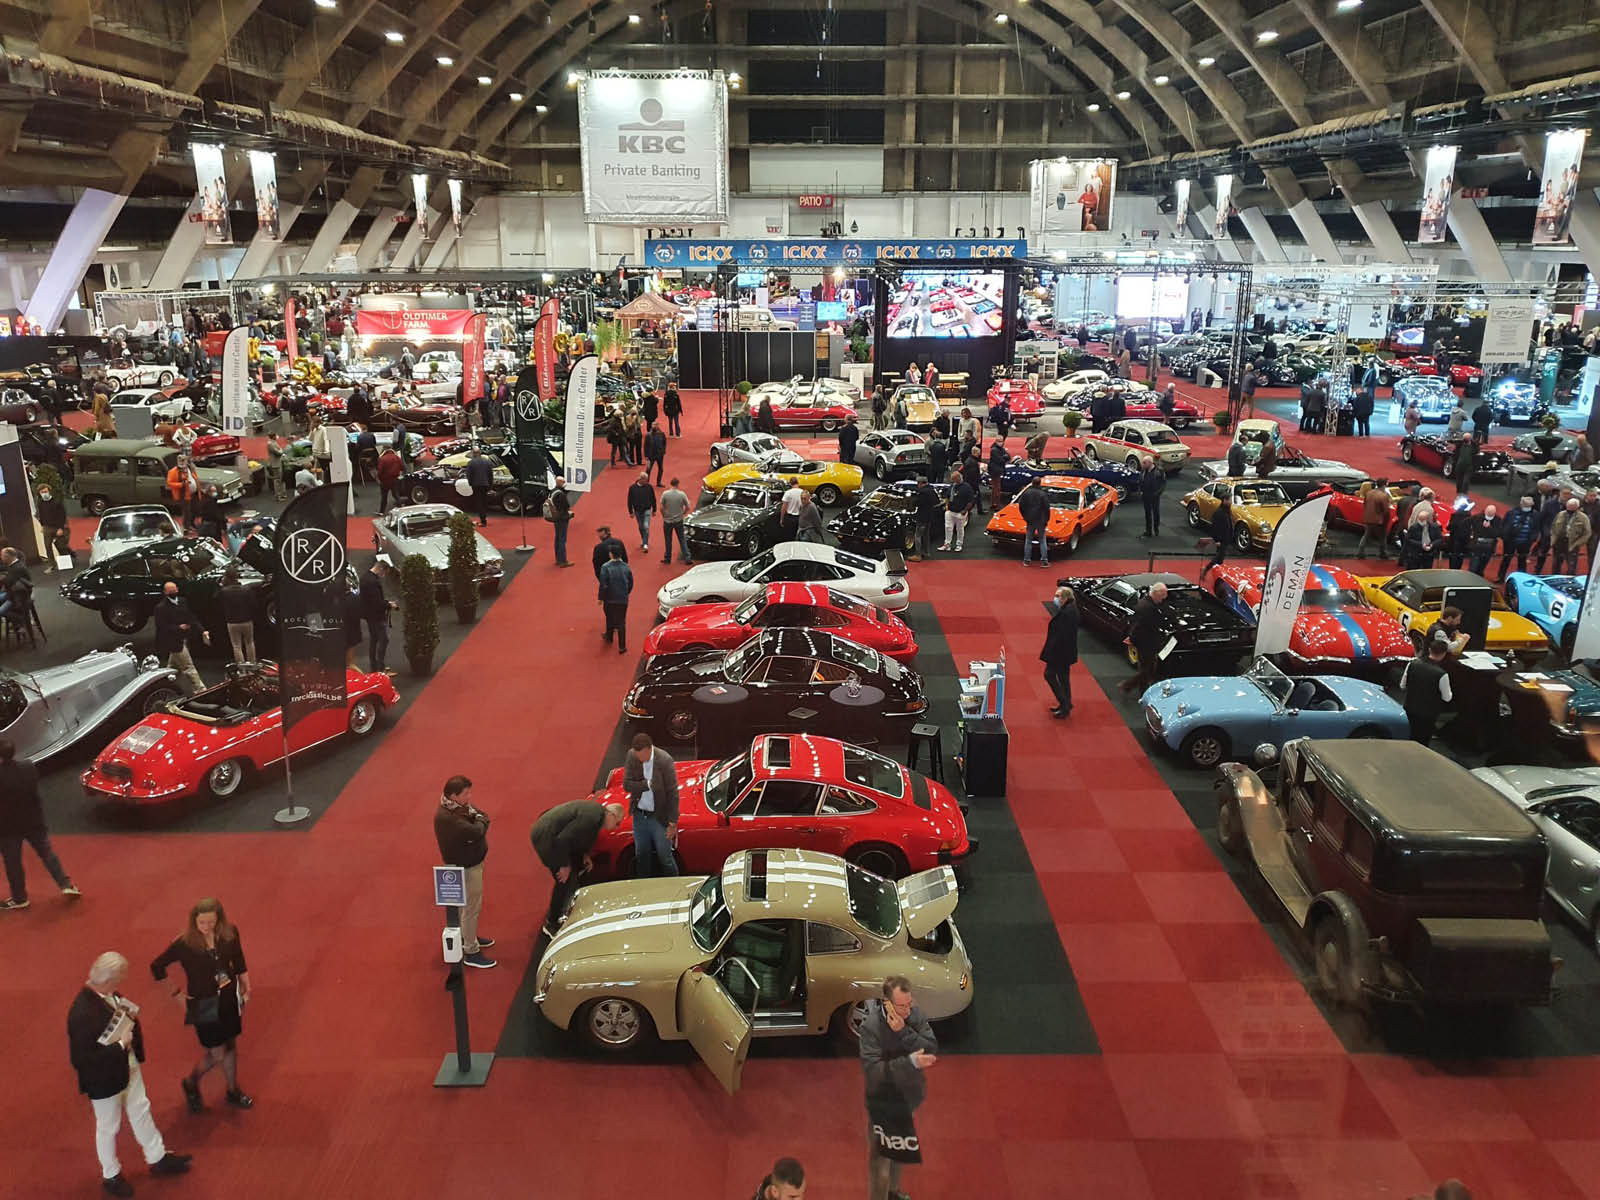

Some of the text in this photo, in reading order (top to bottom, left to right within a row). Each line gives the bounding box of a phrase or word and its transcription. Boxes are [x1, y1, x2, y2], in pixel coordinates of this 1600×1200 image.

[618, 135, 686, 154] KBC
[604, 163, 700, 180] Private Banking
[800, 196, 822, 206] PATIO
[689, 245, 734, 261] ICKX
[783, 245, 828, 260] ICKX
[876, 245, 921, 259] ICKX
[970, 245, 1015, 259] ICKX
[402, 312, 449, 321] OLDTIMER
[528, 407, 536, 417] R
[575, 367, 588, 464] Gentleman Driver Center
[297, 538, 309, 554] R
[312, 559, 324, 575] R
[1283, 555, 1305, 610] DEMAN
[1551, 600, 1564, 619] 6
